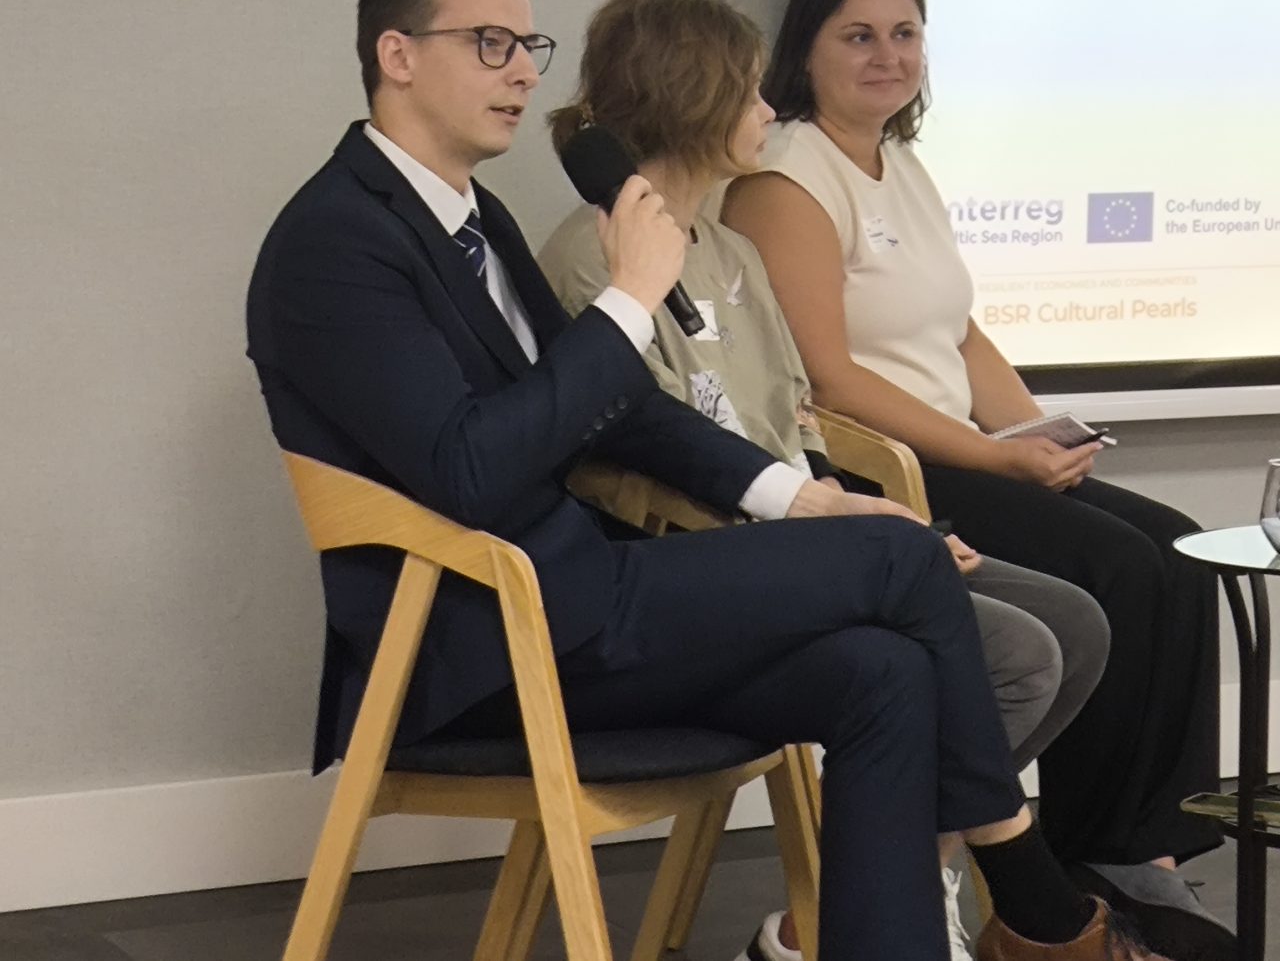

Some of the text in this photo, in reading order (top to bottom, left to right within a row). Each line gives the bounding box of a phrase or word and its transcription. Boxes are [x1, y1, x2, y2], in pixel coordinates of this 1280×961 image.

[948, 196, 1064, 226] nterreg
[1165, 197, 1262, 214] Co-funded by
[1165, 220, 1188, 234] the
[1192, 218, 1260, 235] European
[981, 229, 1008, 244] Sea
[1011, 227, 1064, 246] Region
[984, 296, 1199, 326] BSR Cultural Pearls
